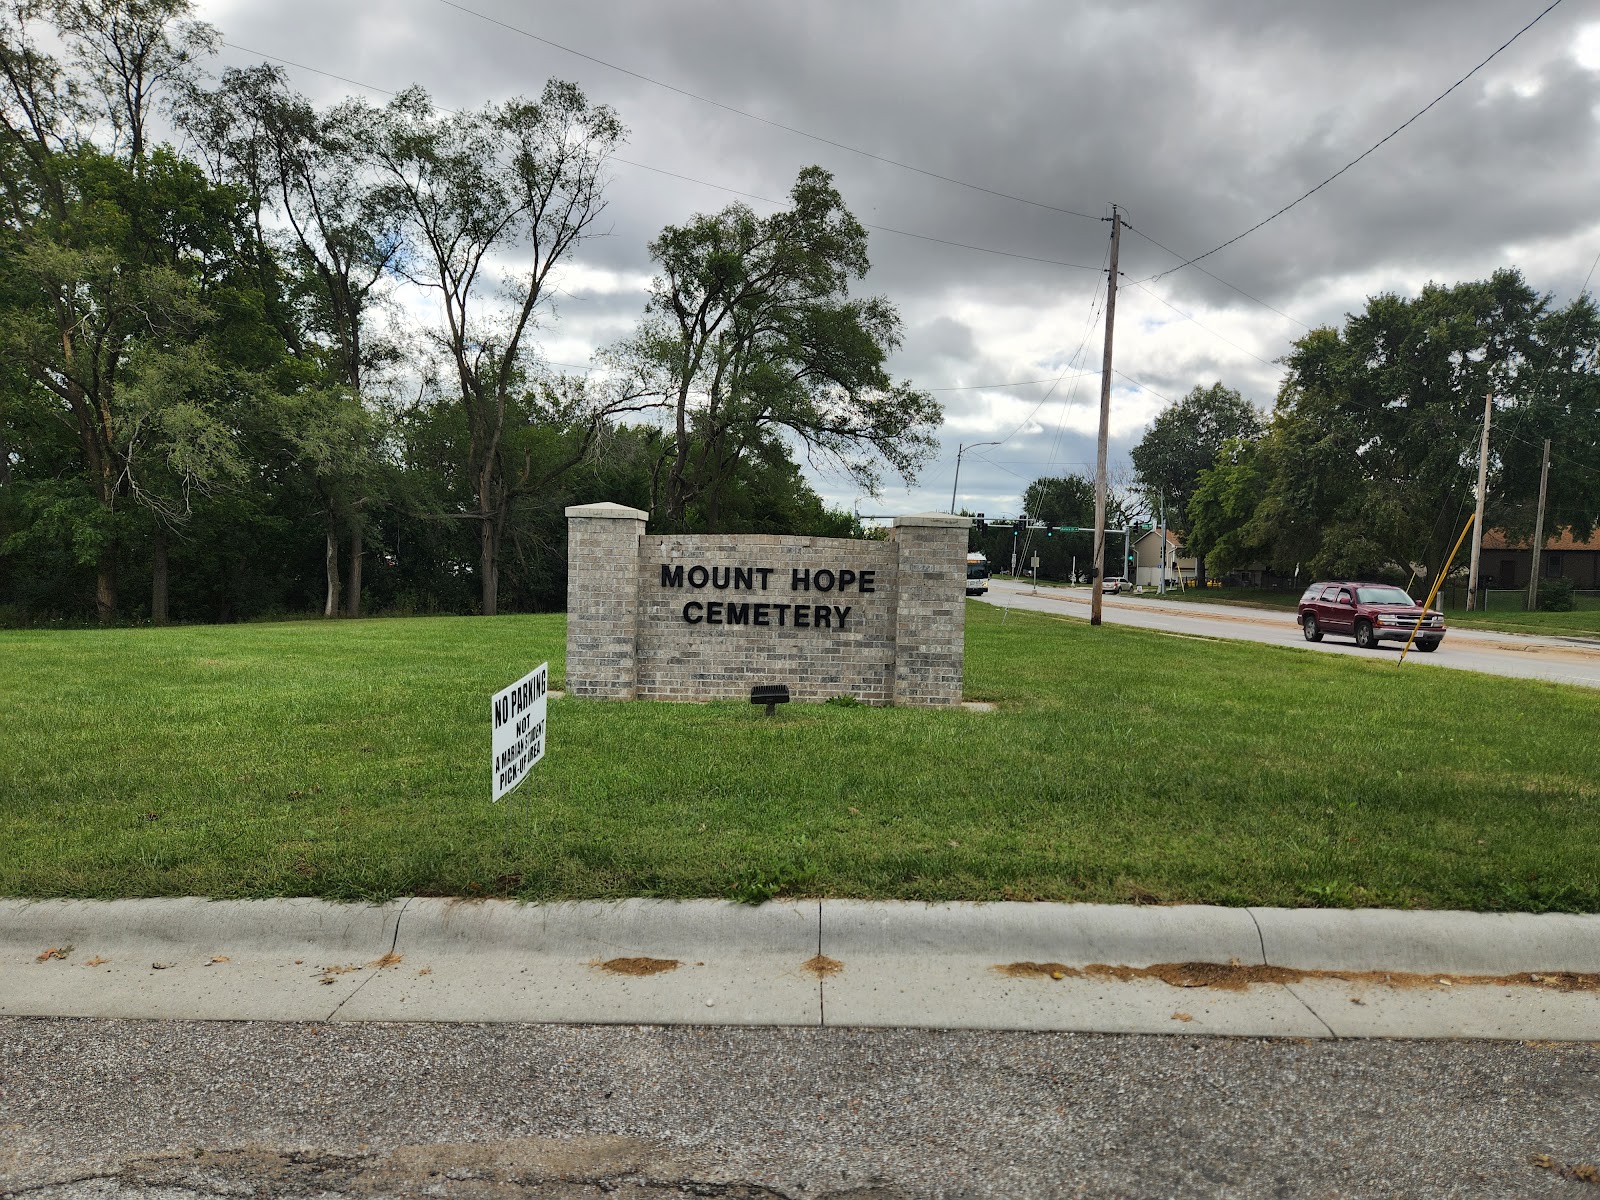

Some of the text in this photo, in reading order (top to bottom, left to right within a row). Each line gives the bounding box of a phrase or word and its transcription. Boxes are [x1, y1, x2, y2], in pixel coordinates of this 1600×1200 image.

[661, 564, 876, 593] MOUNT HOPE
[682, 601, 852, 629] CEMETERY
[494, 669, 546, 729] NO PARKING
[516, 713, 531, 738] NOT
[495, 719, 545, 774] A MARIAN STUDENT
[500, 740, 541, 790] PICK-UP AREA
